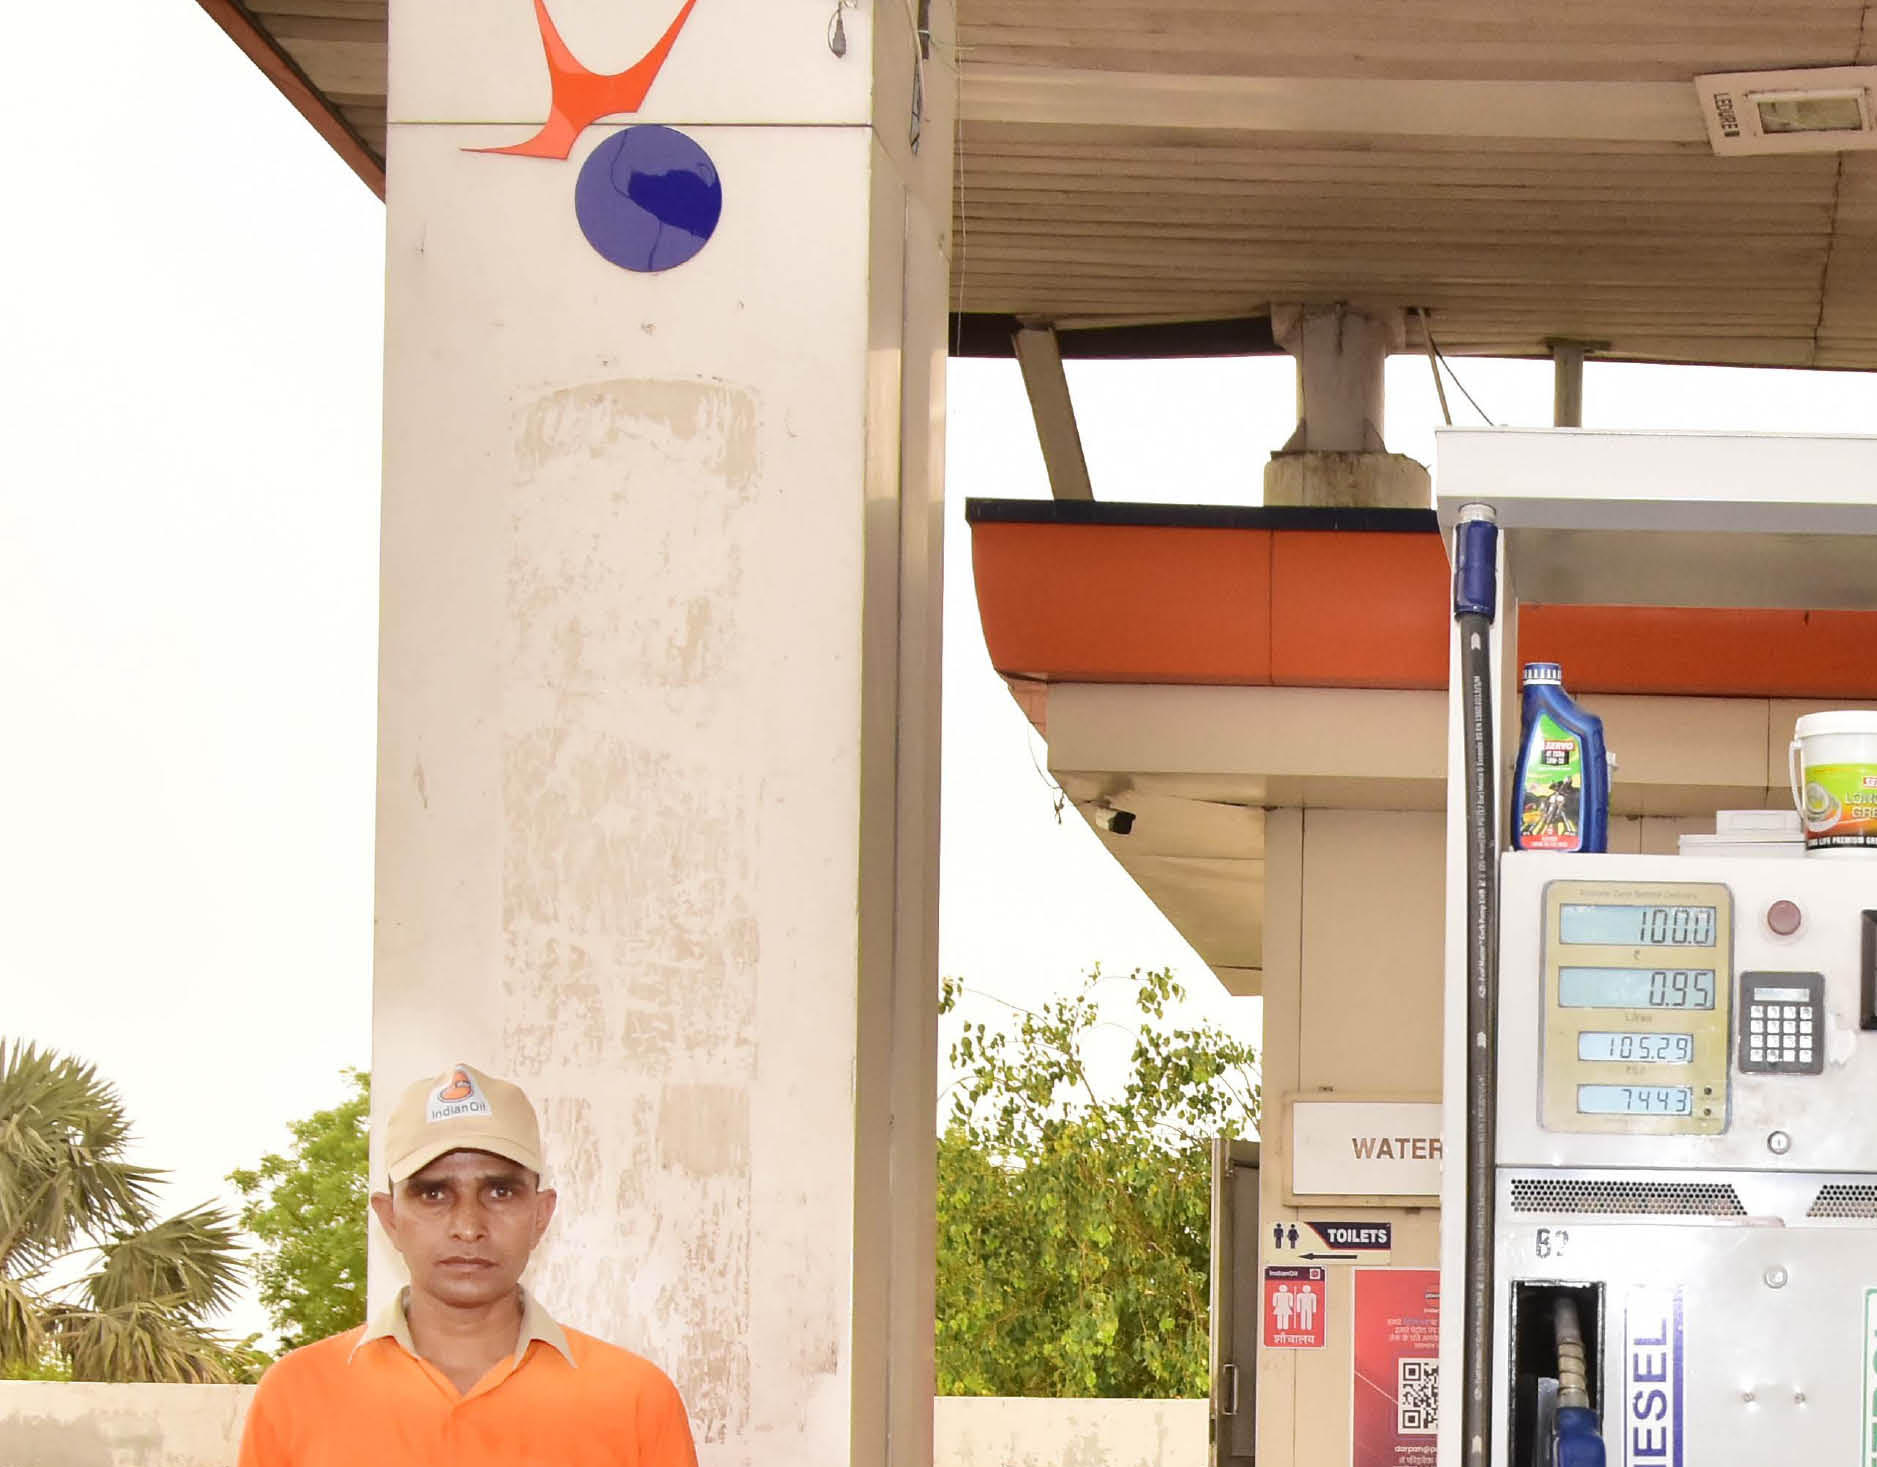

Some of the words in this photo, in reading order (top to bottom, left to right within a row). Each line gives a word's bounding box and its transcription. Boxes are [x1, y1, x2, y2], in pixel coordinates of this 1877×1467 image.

[1650, 971, 1709, 1007] 0.95
[1609, 1036, 1688, 1060] 105.29
[1352, 1137, 1443, 1160] WATER
[1327, 1228, 1388, 1244] TOILETS
